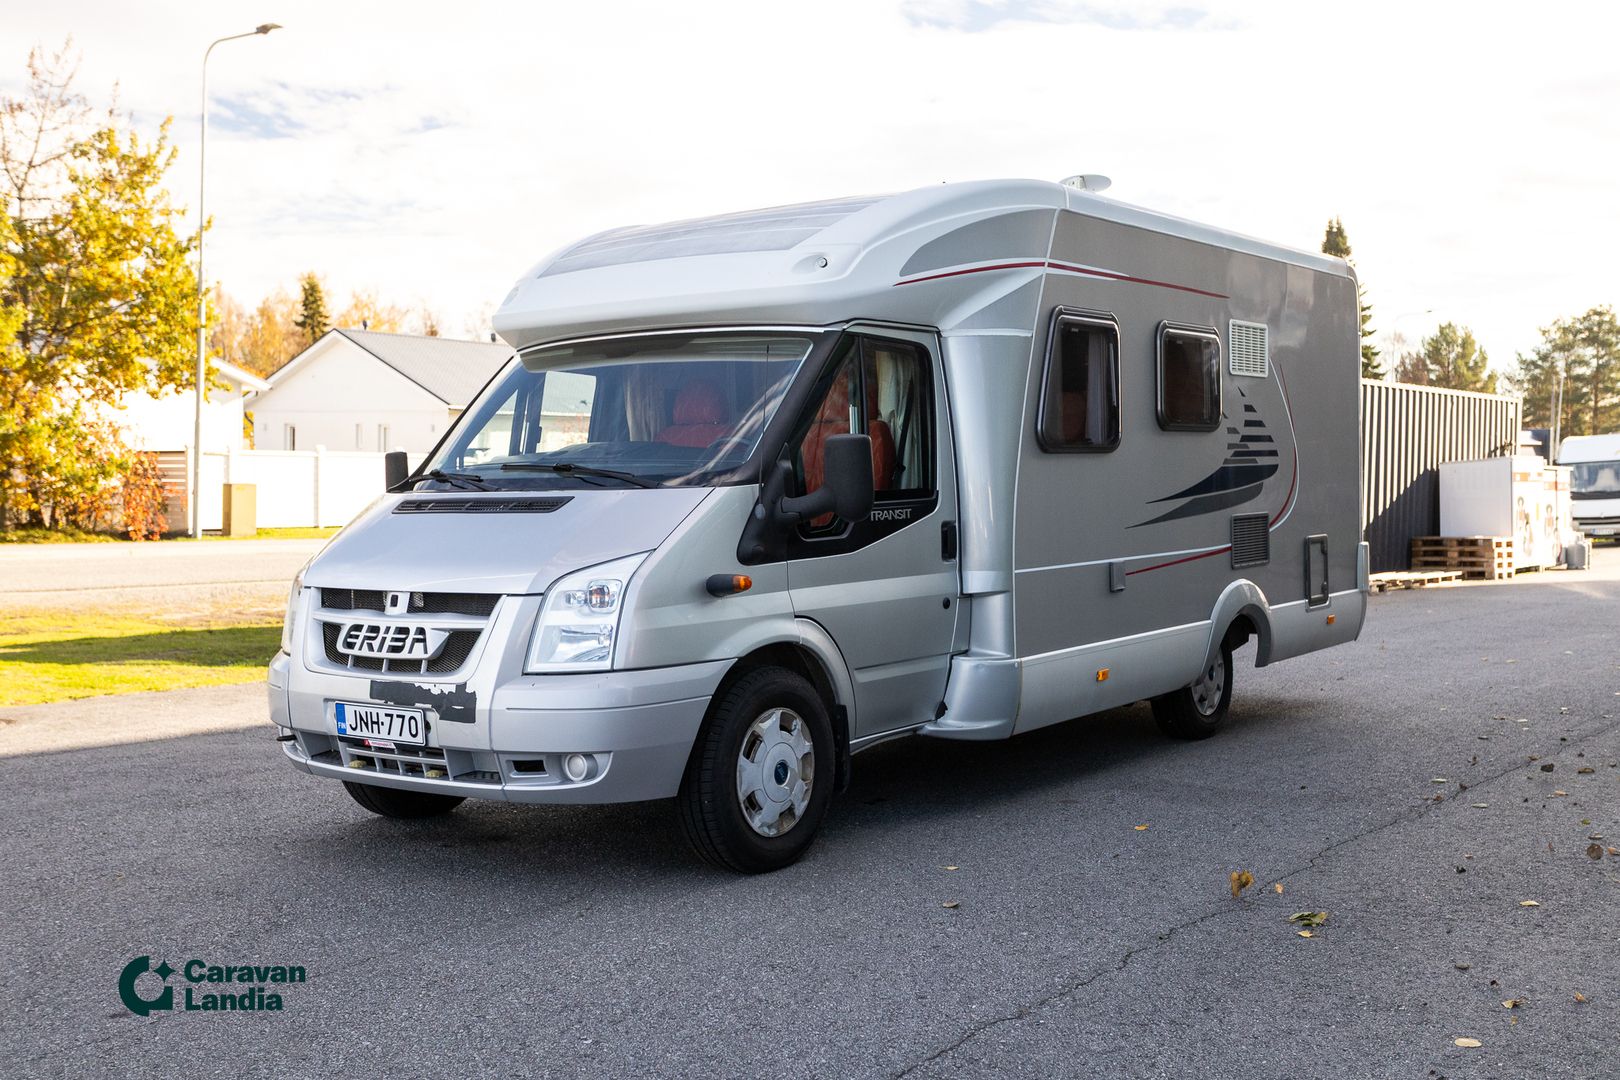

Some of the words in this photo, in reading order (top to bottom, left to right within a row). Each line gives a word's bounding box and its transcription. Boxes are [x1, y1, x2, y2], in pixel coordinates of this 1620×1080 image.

[870, 508, 912, 521] TRANSIT
[342, 623, 429, 655] ERIBA
[349, 709, 419, 738] JNH-770
